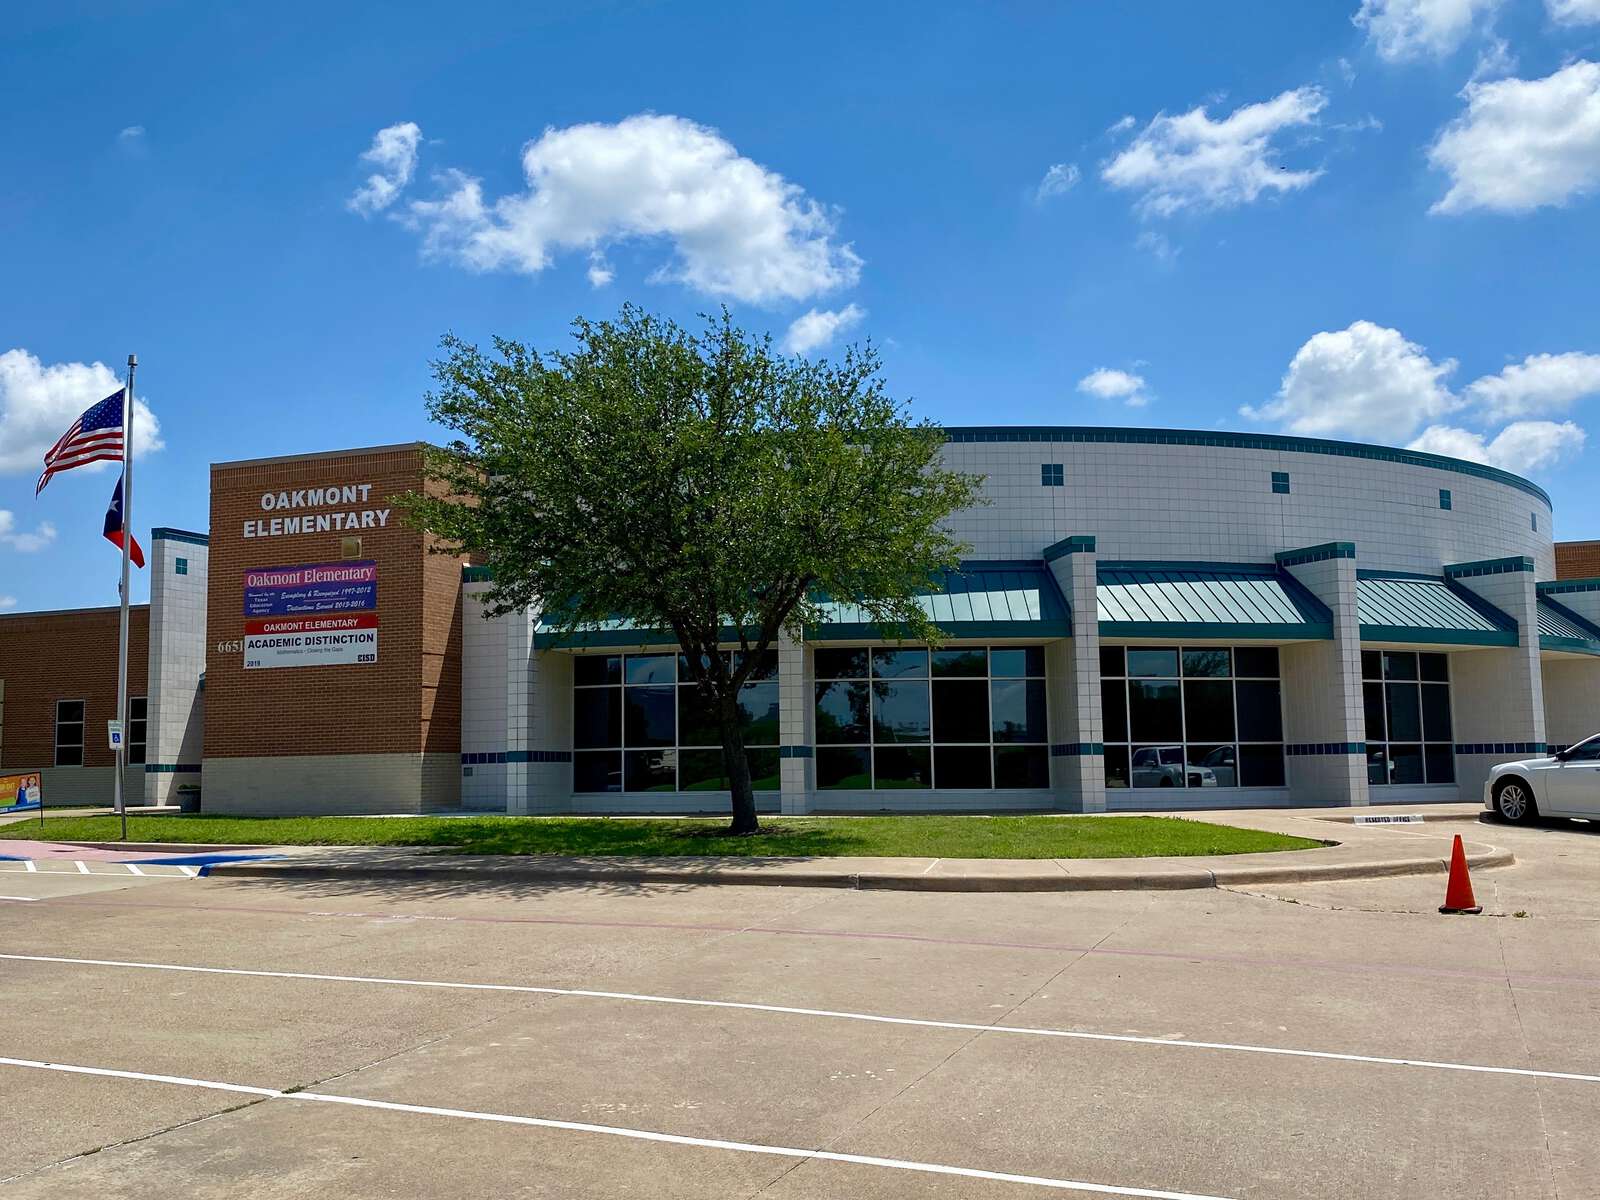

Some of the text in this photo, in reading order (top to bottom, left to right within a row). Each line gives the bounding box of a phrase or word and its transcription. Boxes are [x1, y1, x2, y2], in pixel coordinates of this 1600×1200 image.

[261, 484, 372, 511] OAKMONT
[243, 509, 390, 538] ELEMENTARY
[248, 567, 373, 587] Oakmont Elementary
[263, 618, 358, 632] OAKMONT ELEMENTARY
[217, 640, 244, 653] 6651
[247, 633, 374, 649] ACADEMIC DISTINCTION
